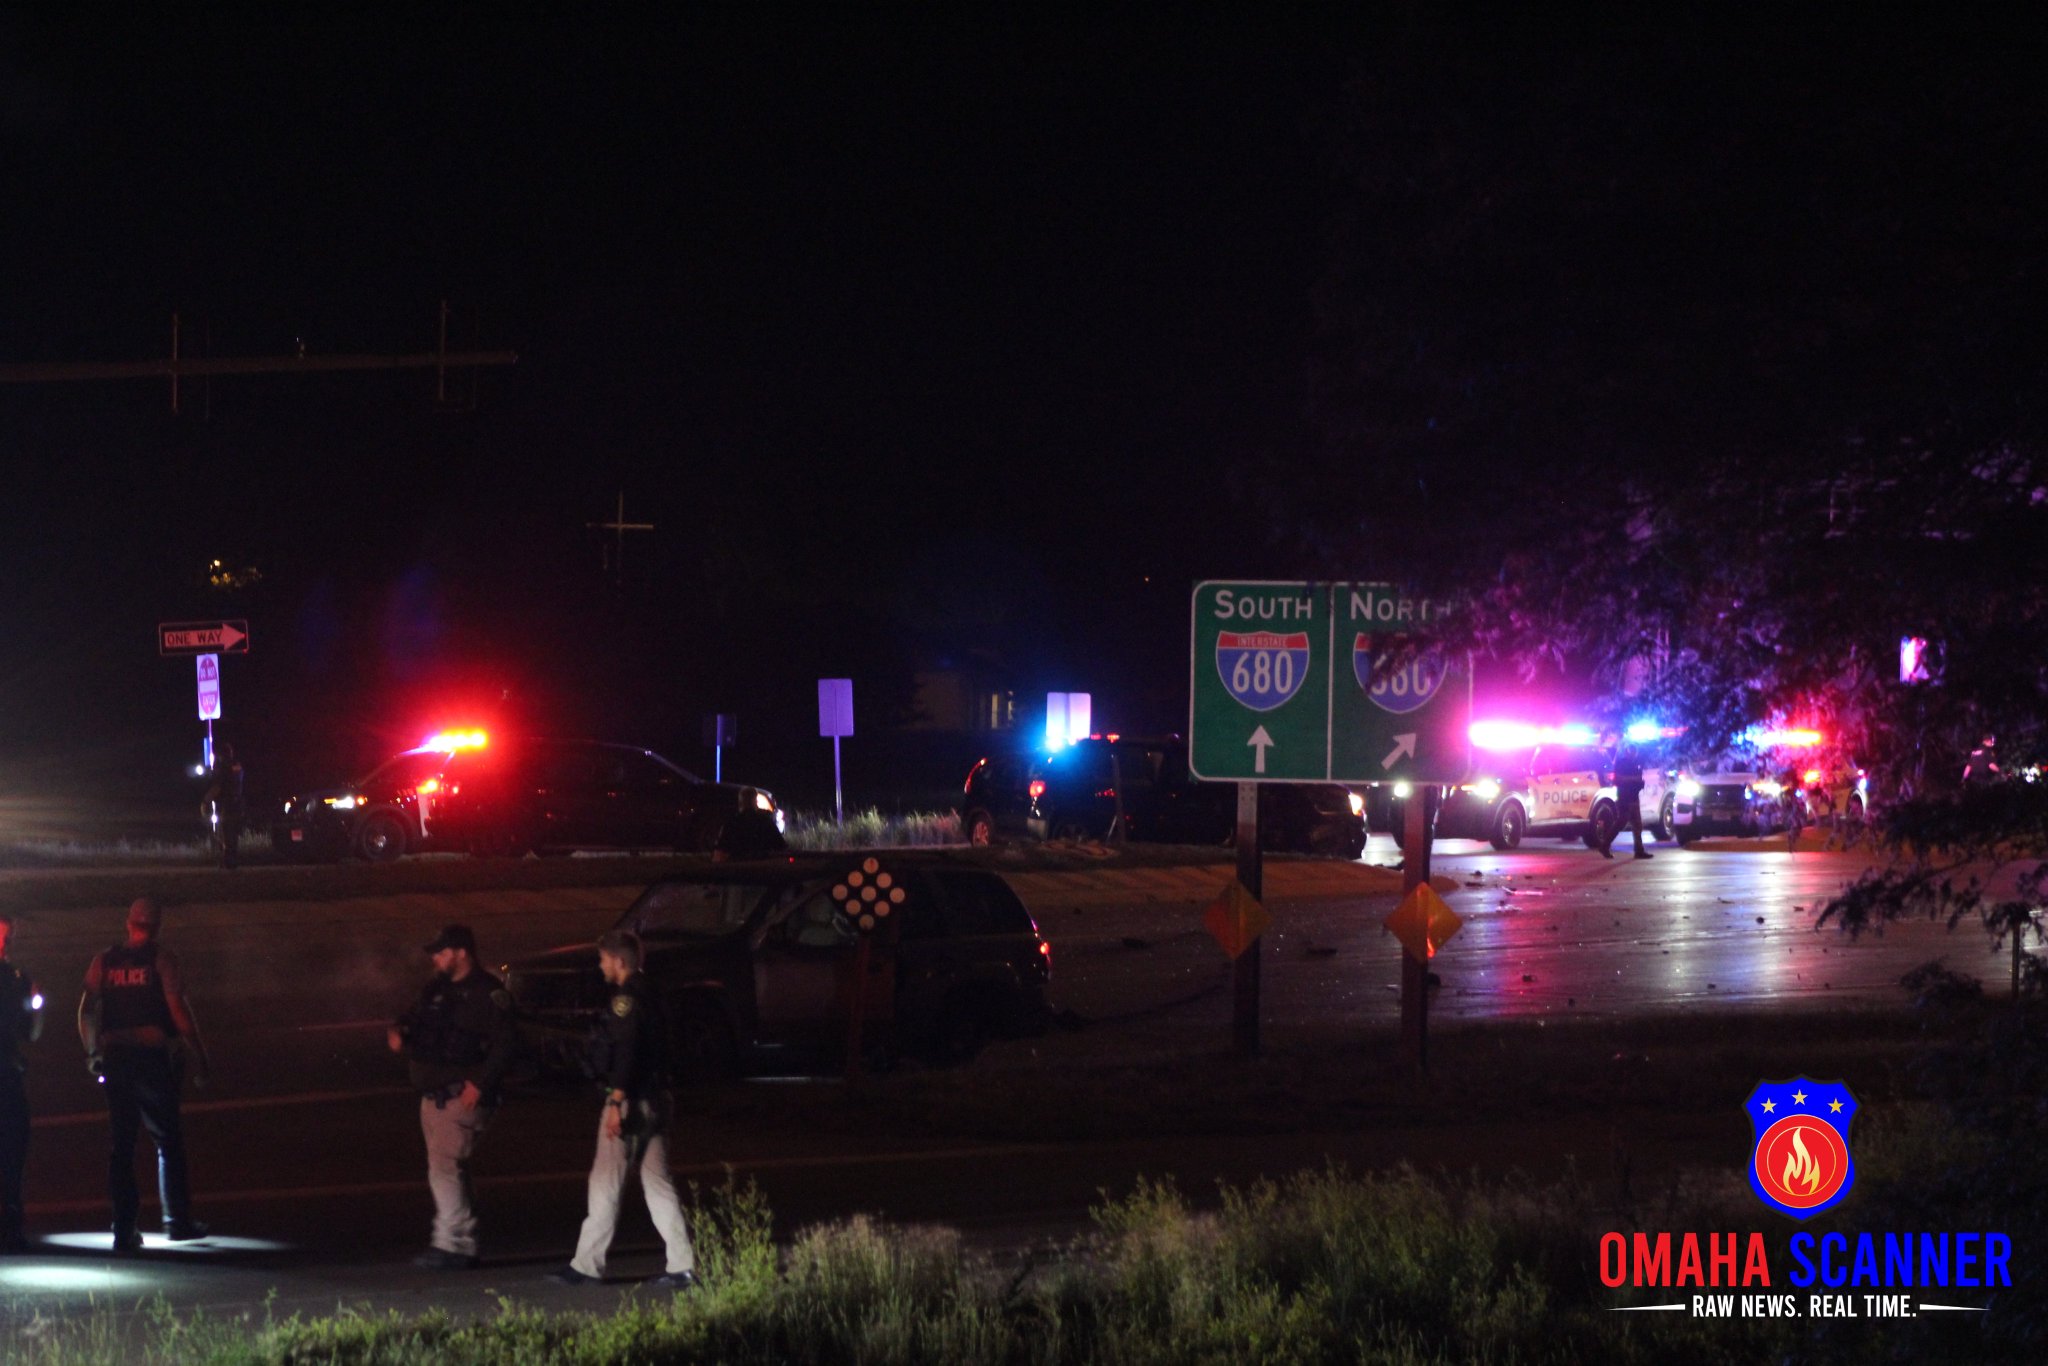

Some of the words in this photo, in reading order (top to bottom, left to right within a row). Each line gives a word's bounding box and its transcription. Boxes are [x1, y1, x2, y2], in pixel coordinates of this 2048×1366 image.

[1214, 590, 1312, 619] SOUTH
[167, 632, 191, 645] ONE
[197, 631, 221, 643] WAY
[1237, 636, 1287, 648] INTERSTATE
[1232, 651, 1293, 694] 680
[1543, 790, 1587, 805] POLICE
[109, 968, 147, 986] POLICE
